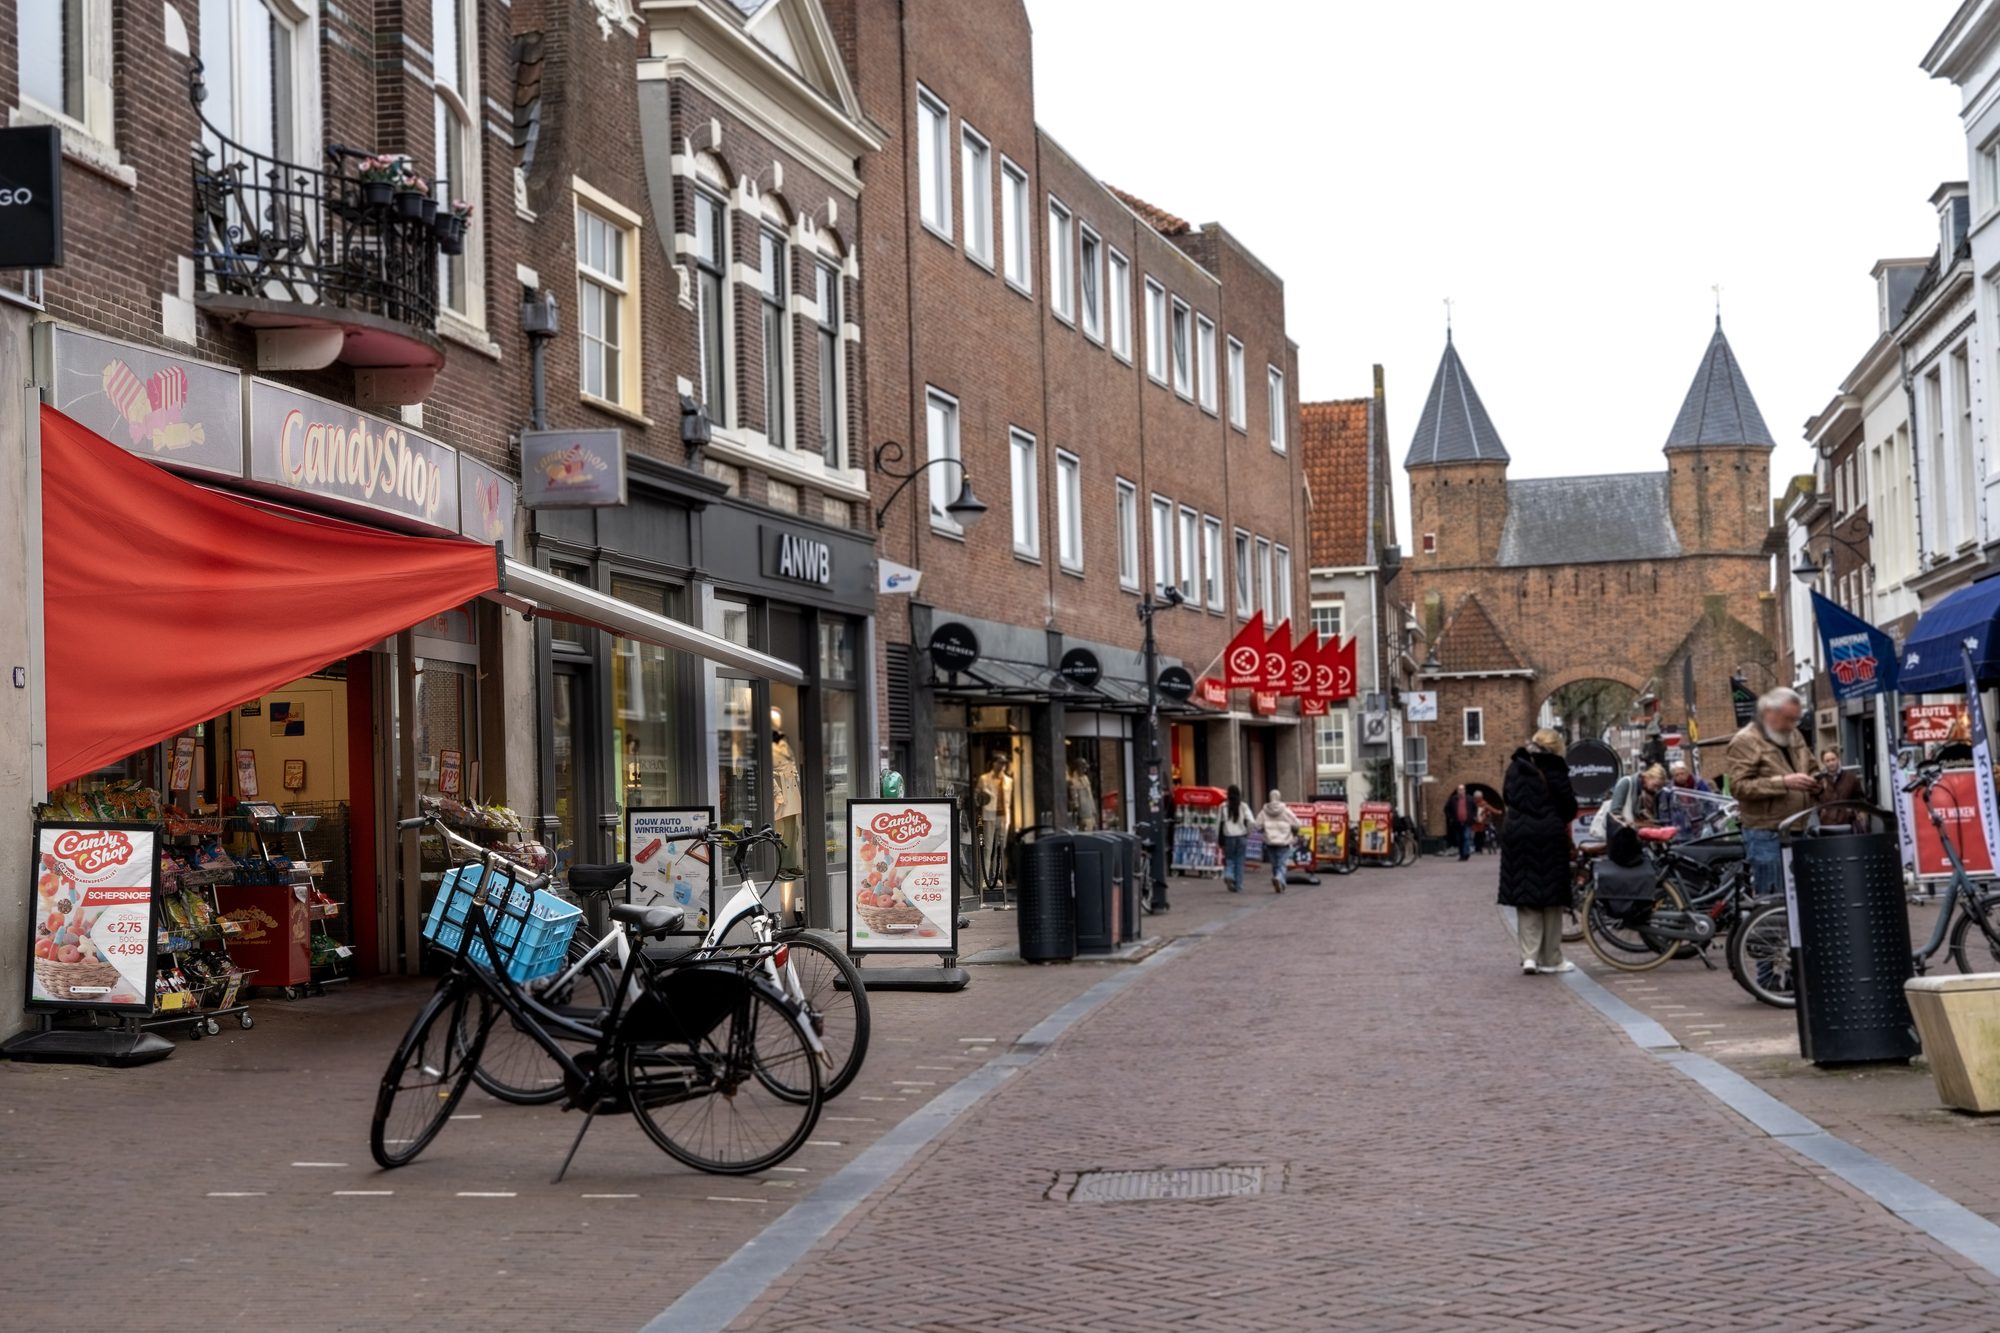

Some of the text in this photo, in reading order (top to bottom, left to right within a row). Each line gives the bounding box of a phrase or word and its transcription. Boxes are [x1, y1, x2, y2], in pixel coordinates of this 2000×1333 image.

[780, 533, 830, 584] ANWB
[1910, 706, 1952, 718] SLEUTEL
[1913, 728, 1949, 740] SERVIC
[634, 818, 659, 826] JOUW
[875, 812, 921, 831] Candy
[635, 826, 692, 834] WINTERKLAAR!
[897, 823, 928, 841] Shop
[58, 831, 120, 855] Candy
[85, 845, 128, 869] Shop
[900, 855, 946, 863] SCHEPSNOEP
